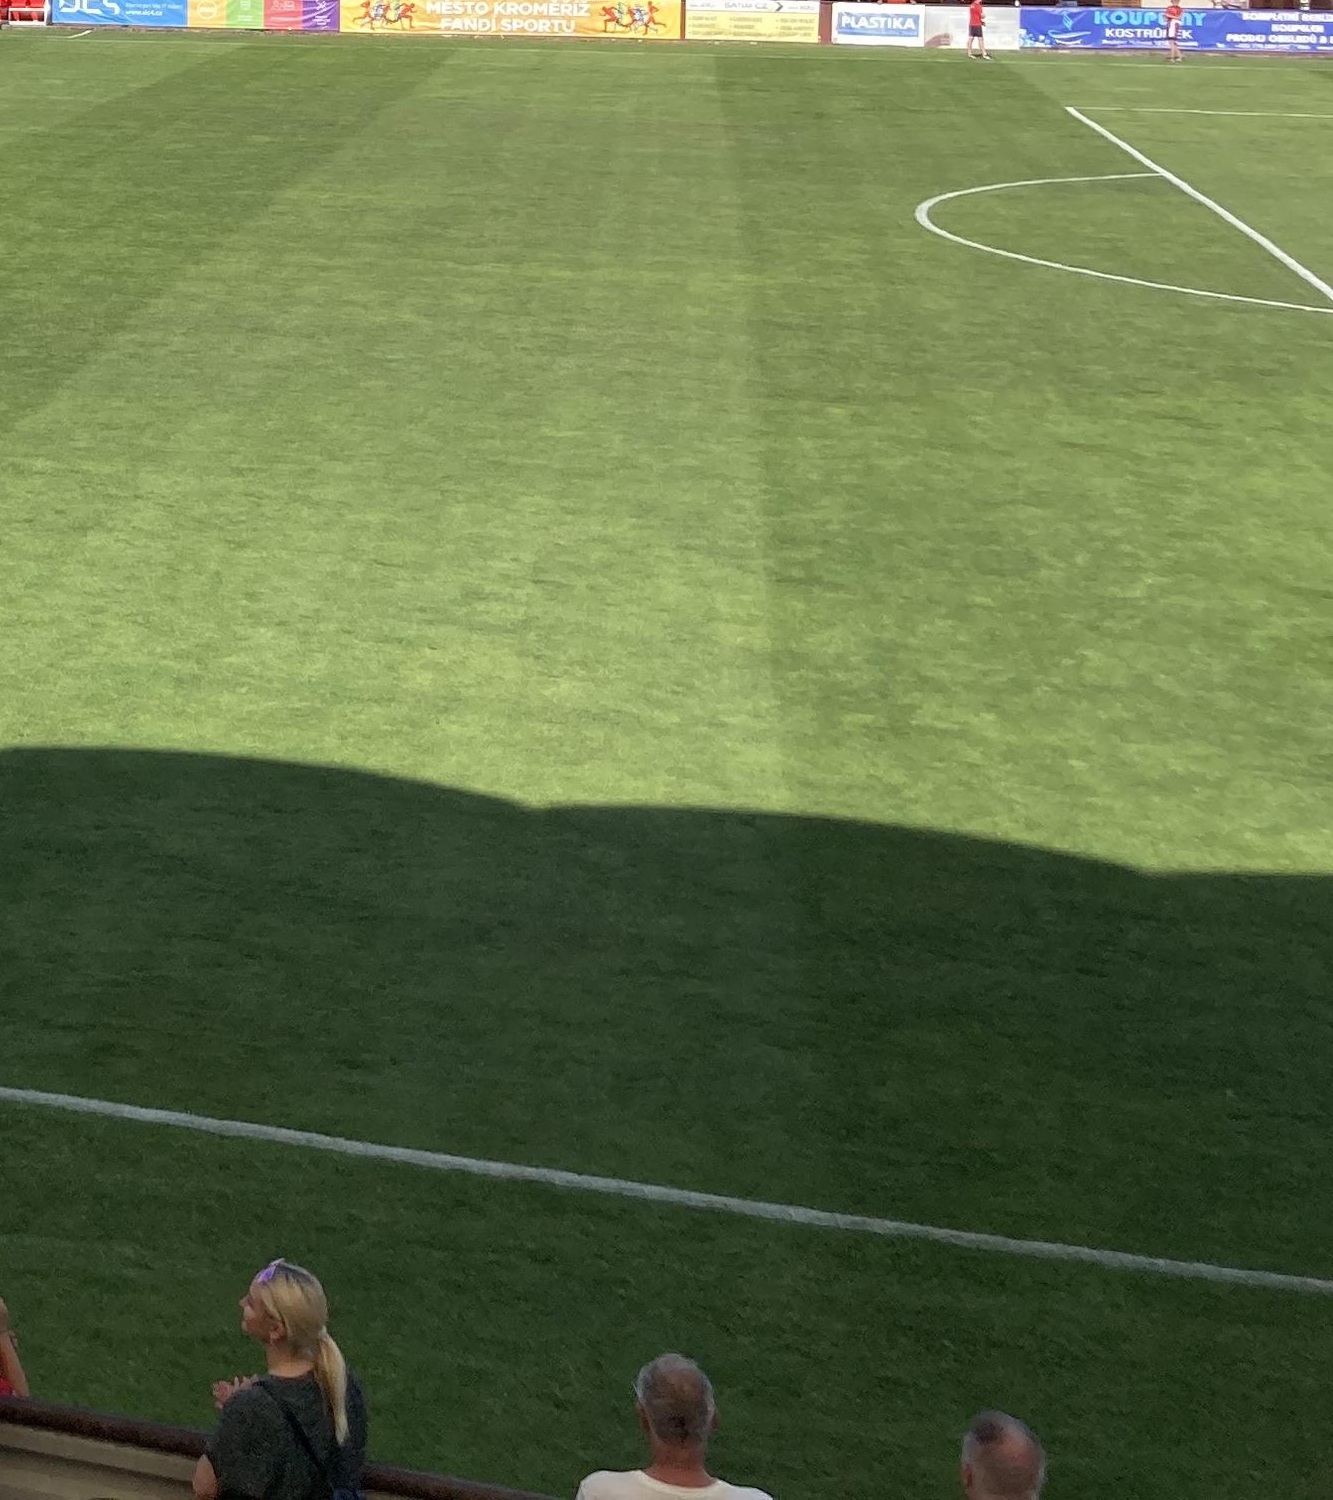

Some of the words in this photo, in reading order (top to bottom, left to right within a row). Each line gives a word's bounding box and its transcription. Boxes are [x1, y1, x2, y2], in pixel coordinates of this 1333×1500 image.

[426, 0, 489, 15] MĚSTO
[494, 0, 591, 17] KROMĚŘÍŽ
[440, 15, 496, 31] FANDÍ
[500, 19, 576, 33] SPORTU
[841, 16, 916, 30] PLASTIKA
